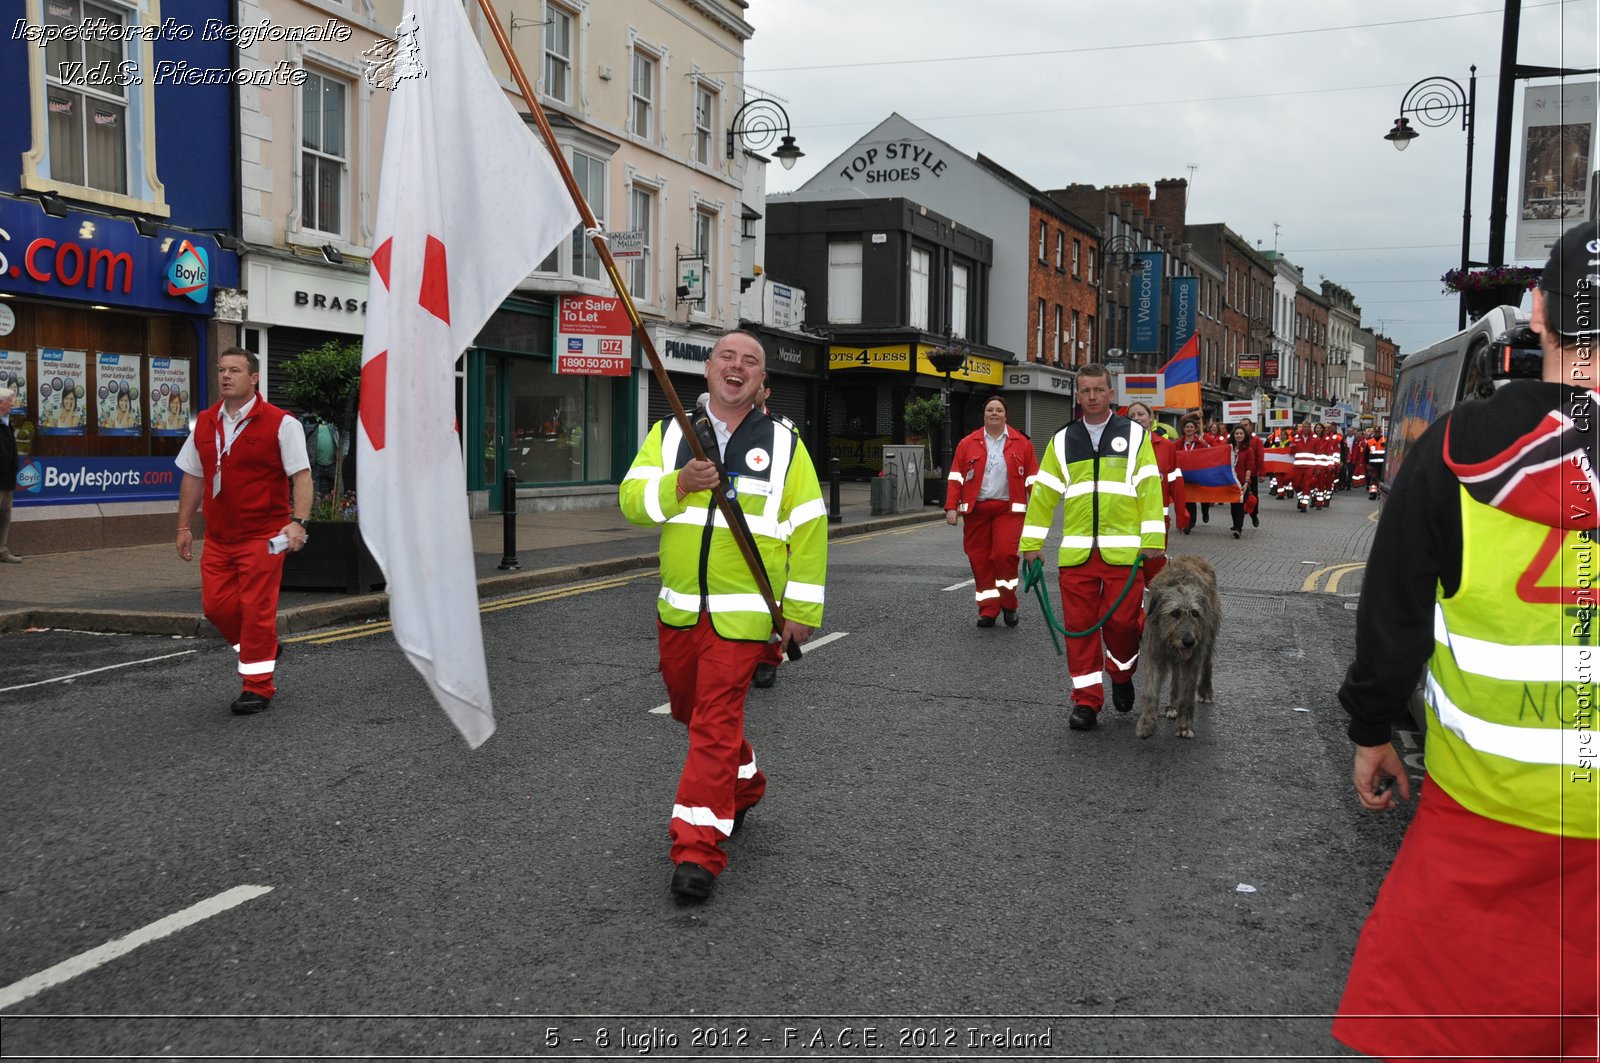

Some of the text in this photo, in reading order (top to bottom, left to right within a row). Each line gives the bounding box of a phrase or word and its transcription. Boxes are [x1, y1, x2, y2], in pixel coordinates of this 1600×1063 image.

[840, 143, 947, 181] TOP STYLE
[866, 167, 920, 183] SHOES
[176, 264, 206, 284] Boyle
[1138, 259, 1152, 323] Welcome
[563, 299, 616, 311] For Sale/
[1176, 284, 1189, 340] Welcome
[563, 310, 598, 322] To Let
[601, 340, 620, 350] DTZ
[562, 358, 624, 368] 1890 50 20 11
[855, 350, 870, 365] 4
[873, 353, 906, 361] LESS
[970, 360, 991, 375] LESS
[1010, 375, 1030, 384] 83
[19, 473, 40, 483] Boyle
[45, 467, 172, 492] Boylesports.com
